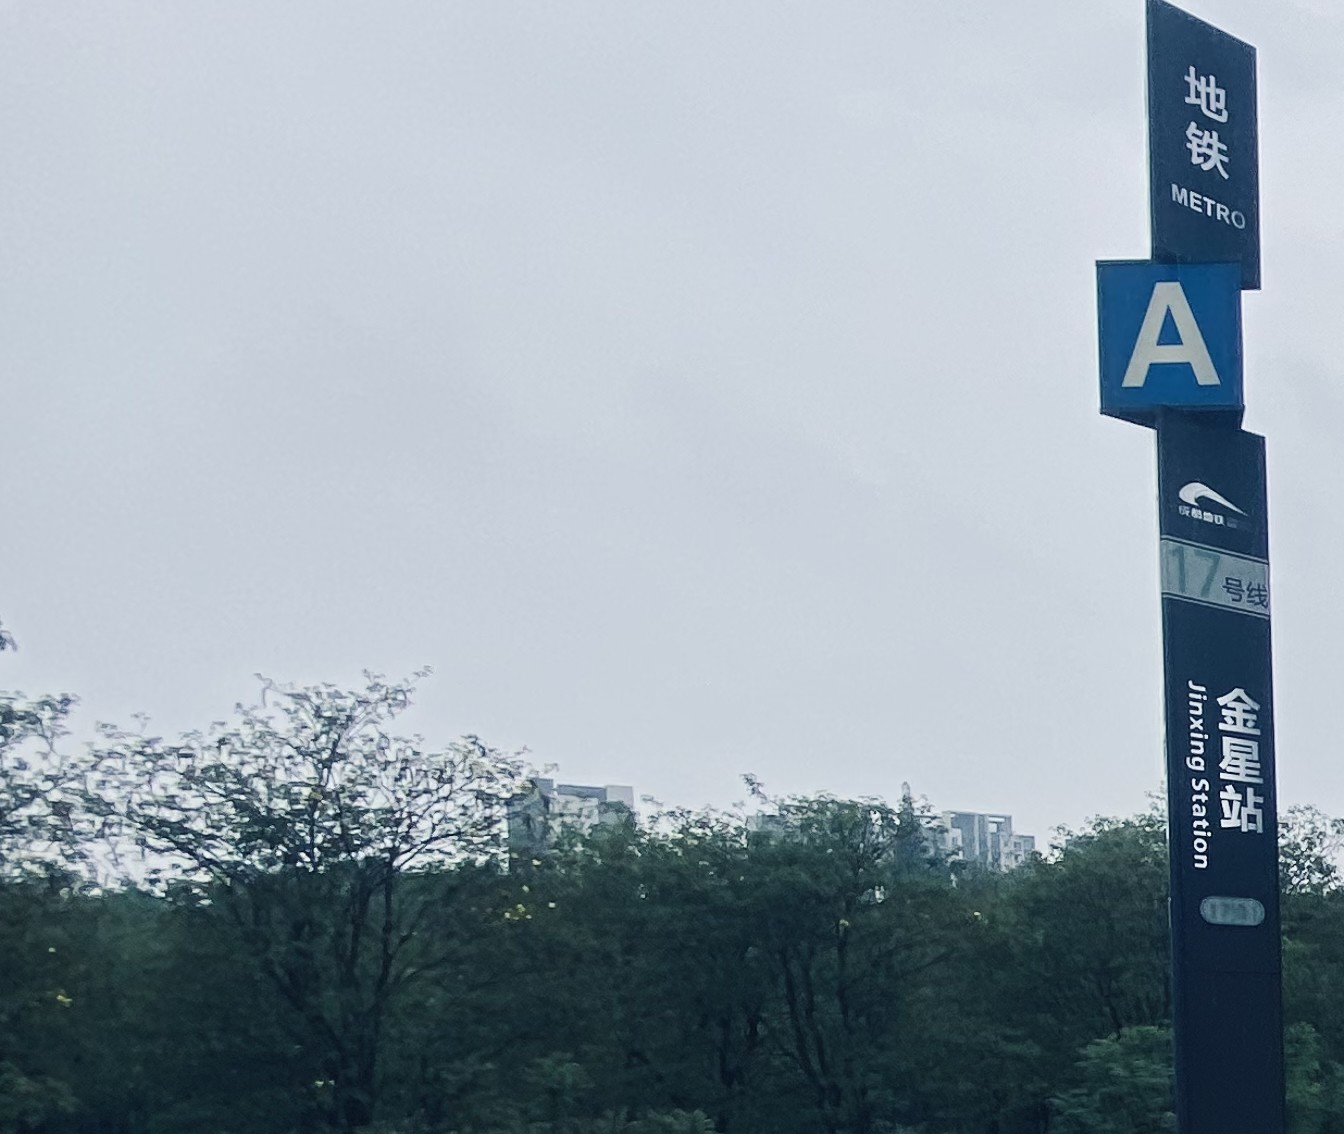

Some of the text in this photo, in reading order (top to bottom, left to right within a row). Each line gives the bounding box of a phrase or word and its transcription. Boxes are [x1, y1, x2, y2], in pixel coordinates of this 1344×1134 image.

[1184, 65, 1229, 180] 地铁
[1170, 183, 1246, 230] METRO
[1121, 281, 1221, 388] A
[1186, 680, 1212, 869] Jinxing Station
[1217, 687, 1264, 834] 金星站
